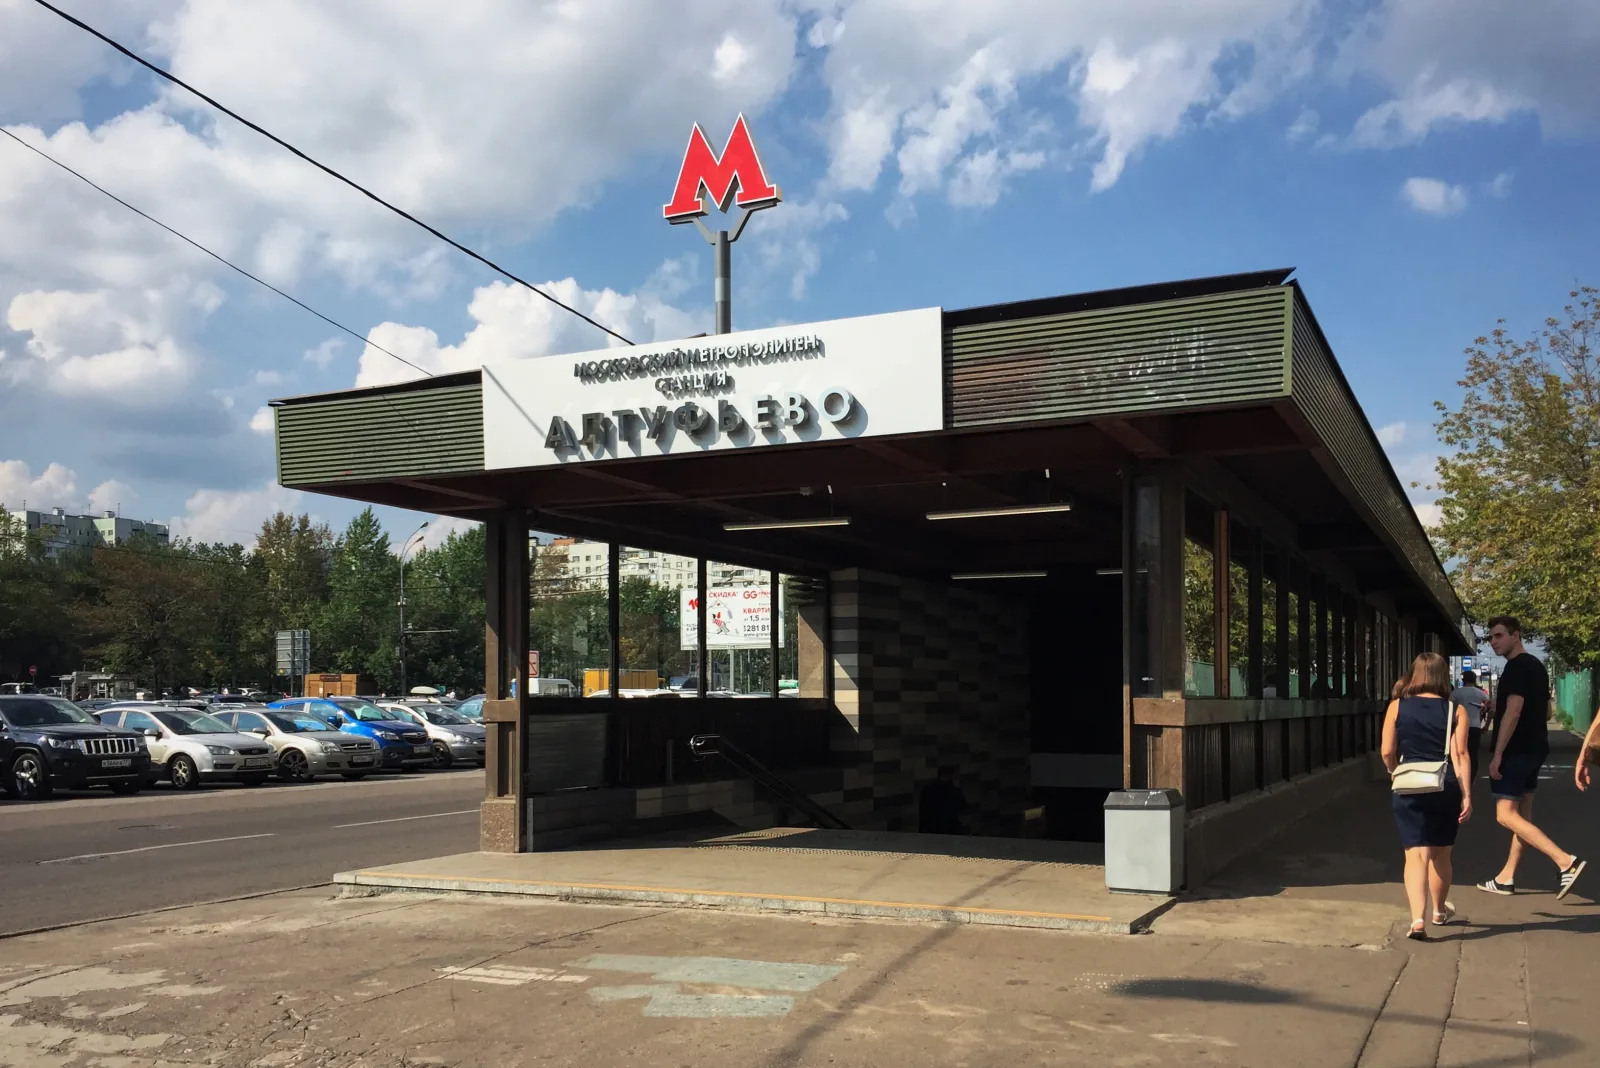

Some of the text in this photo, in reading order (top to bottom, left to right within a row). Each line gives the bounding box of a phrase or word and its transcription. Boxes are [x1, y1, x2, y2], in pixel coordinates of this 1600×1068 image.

[574, 334, 818, 377] МОСКОВСКИЙ МЕТРОПОЛИТЕН
[655, 371, 727, 392] СТАНЦИЯ
[545, 386, 851, 448] АЛТУФЬЕВО
